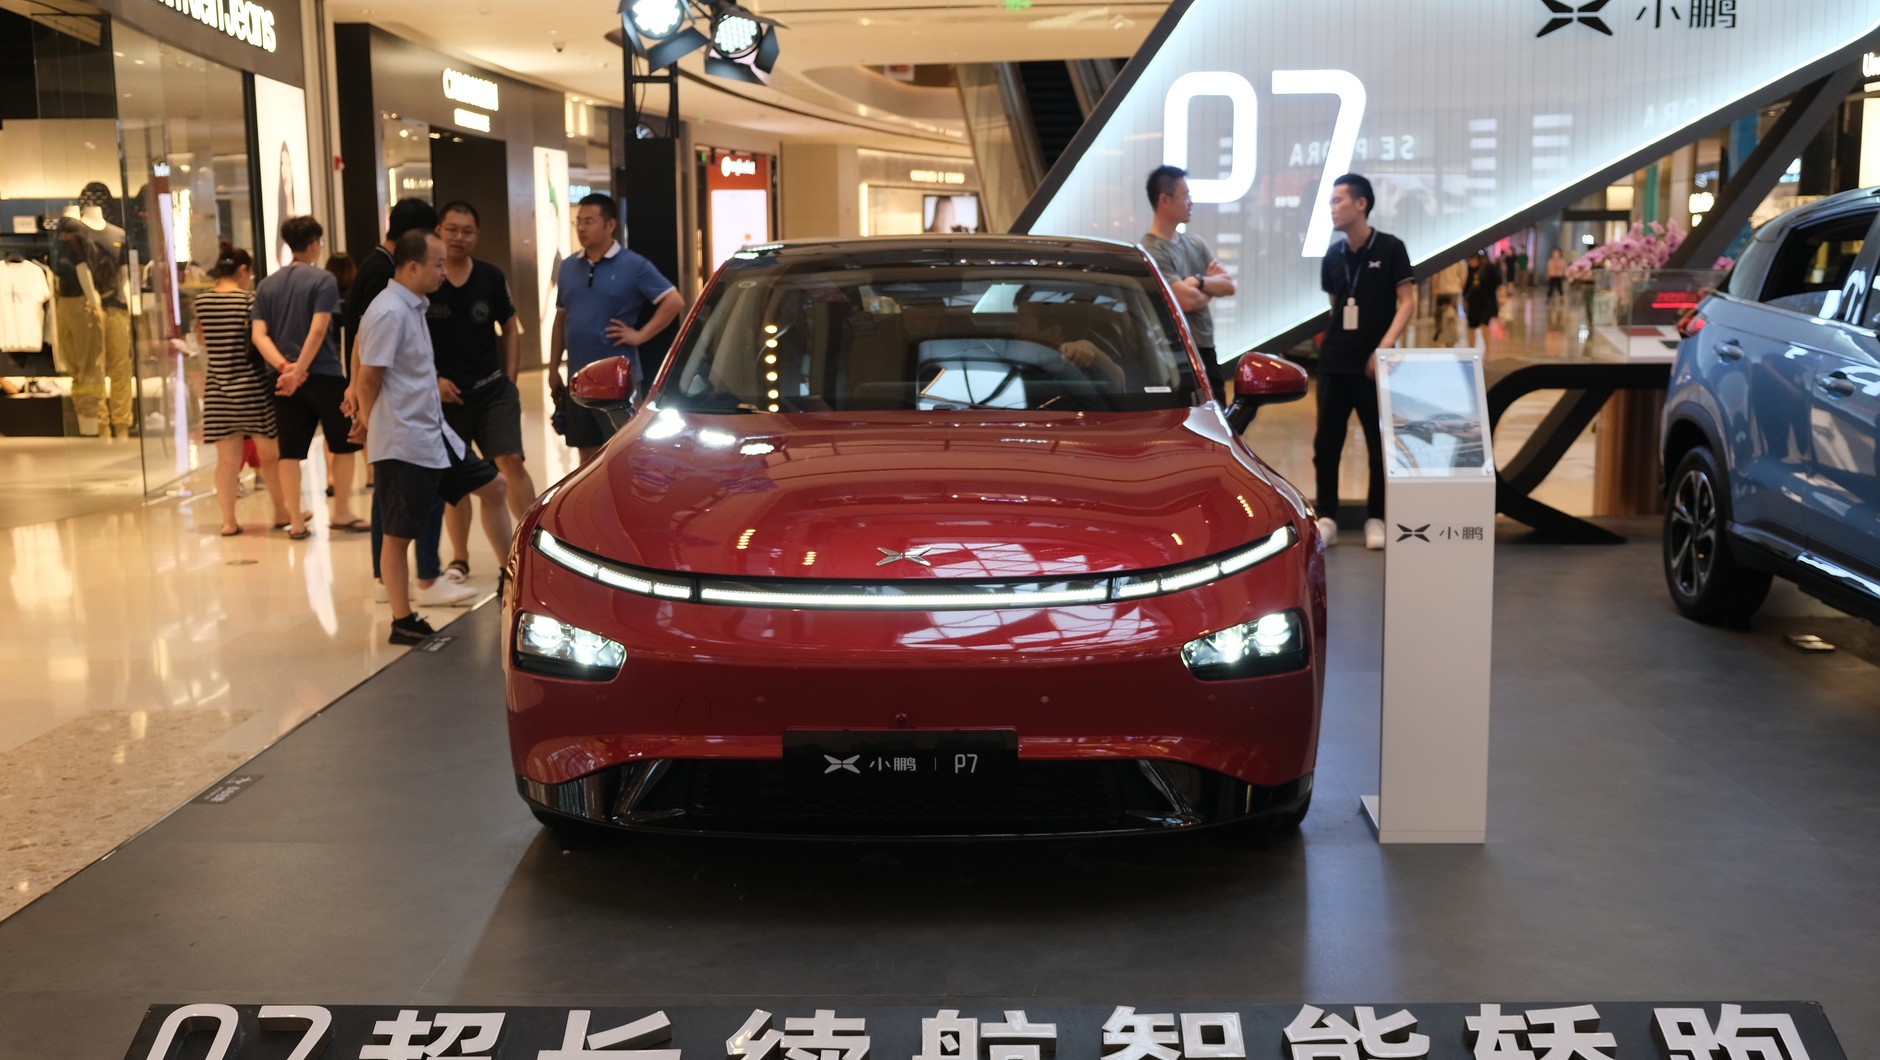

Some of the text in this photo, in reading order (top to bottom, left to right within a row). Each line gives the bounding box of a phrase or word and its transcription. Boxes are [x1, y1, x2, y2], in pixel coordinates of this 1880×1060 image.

[224, 0, 277, 53] Jeans
[1636, 0, 1736, 29] 小鹏
[1163, 69, 1366, 257] 07
[1439, 526, 1483, 540] 小鹏
[869, 753, 978, 774] 小鹏 P7
